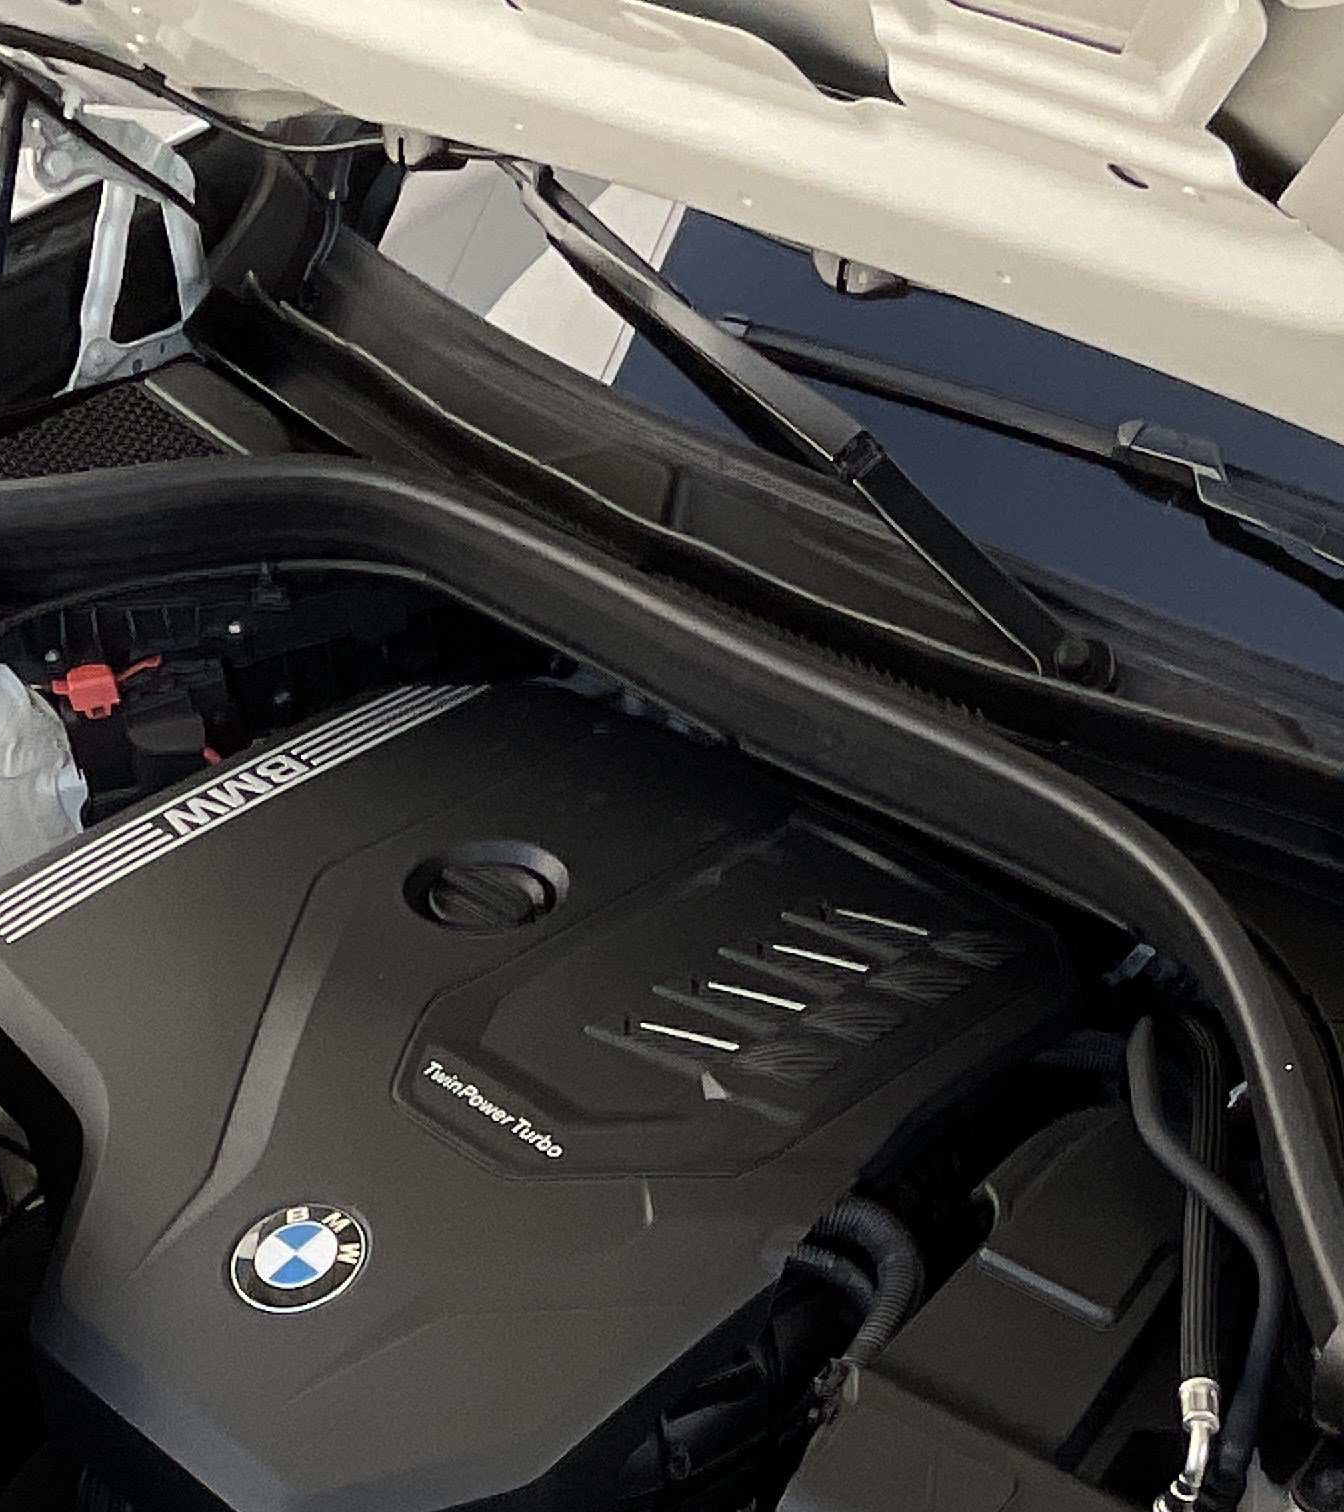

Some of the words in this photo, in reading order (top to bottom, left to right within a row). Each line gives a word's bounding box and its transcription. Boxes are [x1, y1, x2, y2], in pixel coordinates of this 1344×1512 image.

[163, 754, 310, 835] BMW
[423, 1060, 516, 1125] TwinPower
[511, 1117, 563, 1158] Turbo
[285, 1205, 360, 1264] BMW
